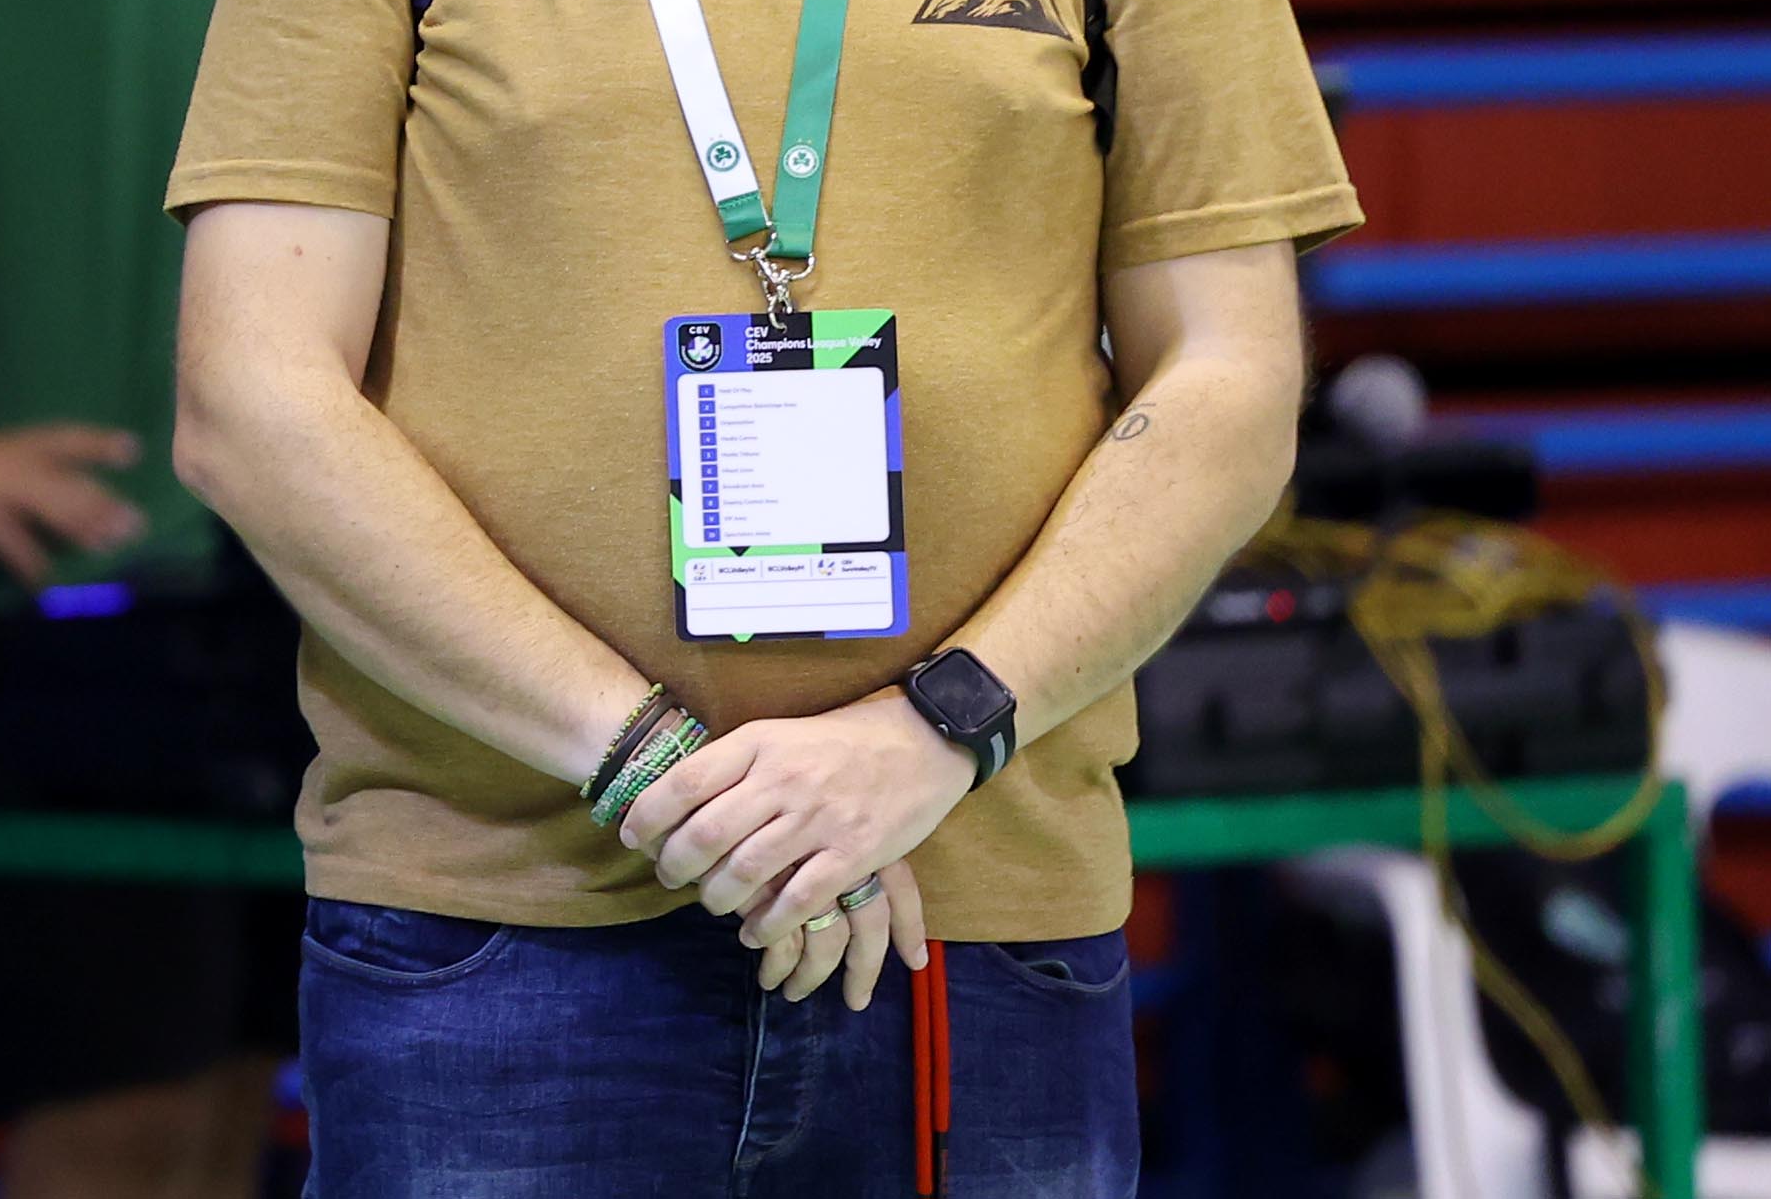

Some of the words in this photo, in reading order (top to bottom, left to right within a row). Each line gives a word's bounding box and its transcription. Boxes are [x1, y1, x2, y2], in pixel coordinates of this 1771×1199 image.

[689, 325, 710, 334] CEV
[745, 326, 769, 338] CEV
[745, 338, 806, 352] Champions
[807, 338, 847, 351] League
[745, 352, 773, 364] 2025
